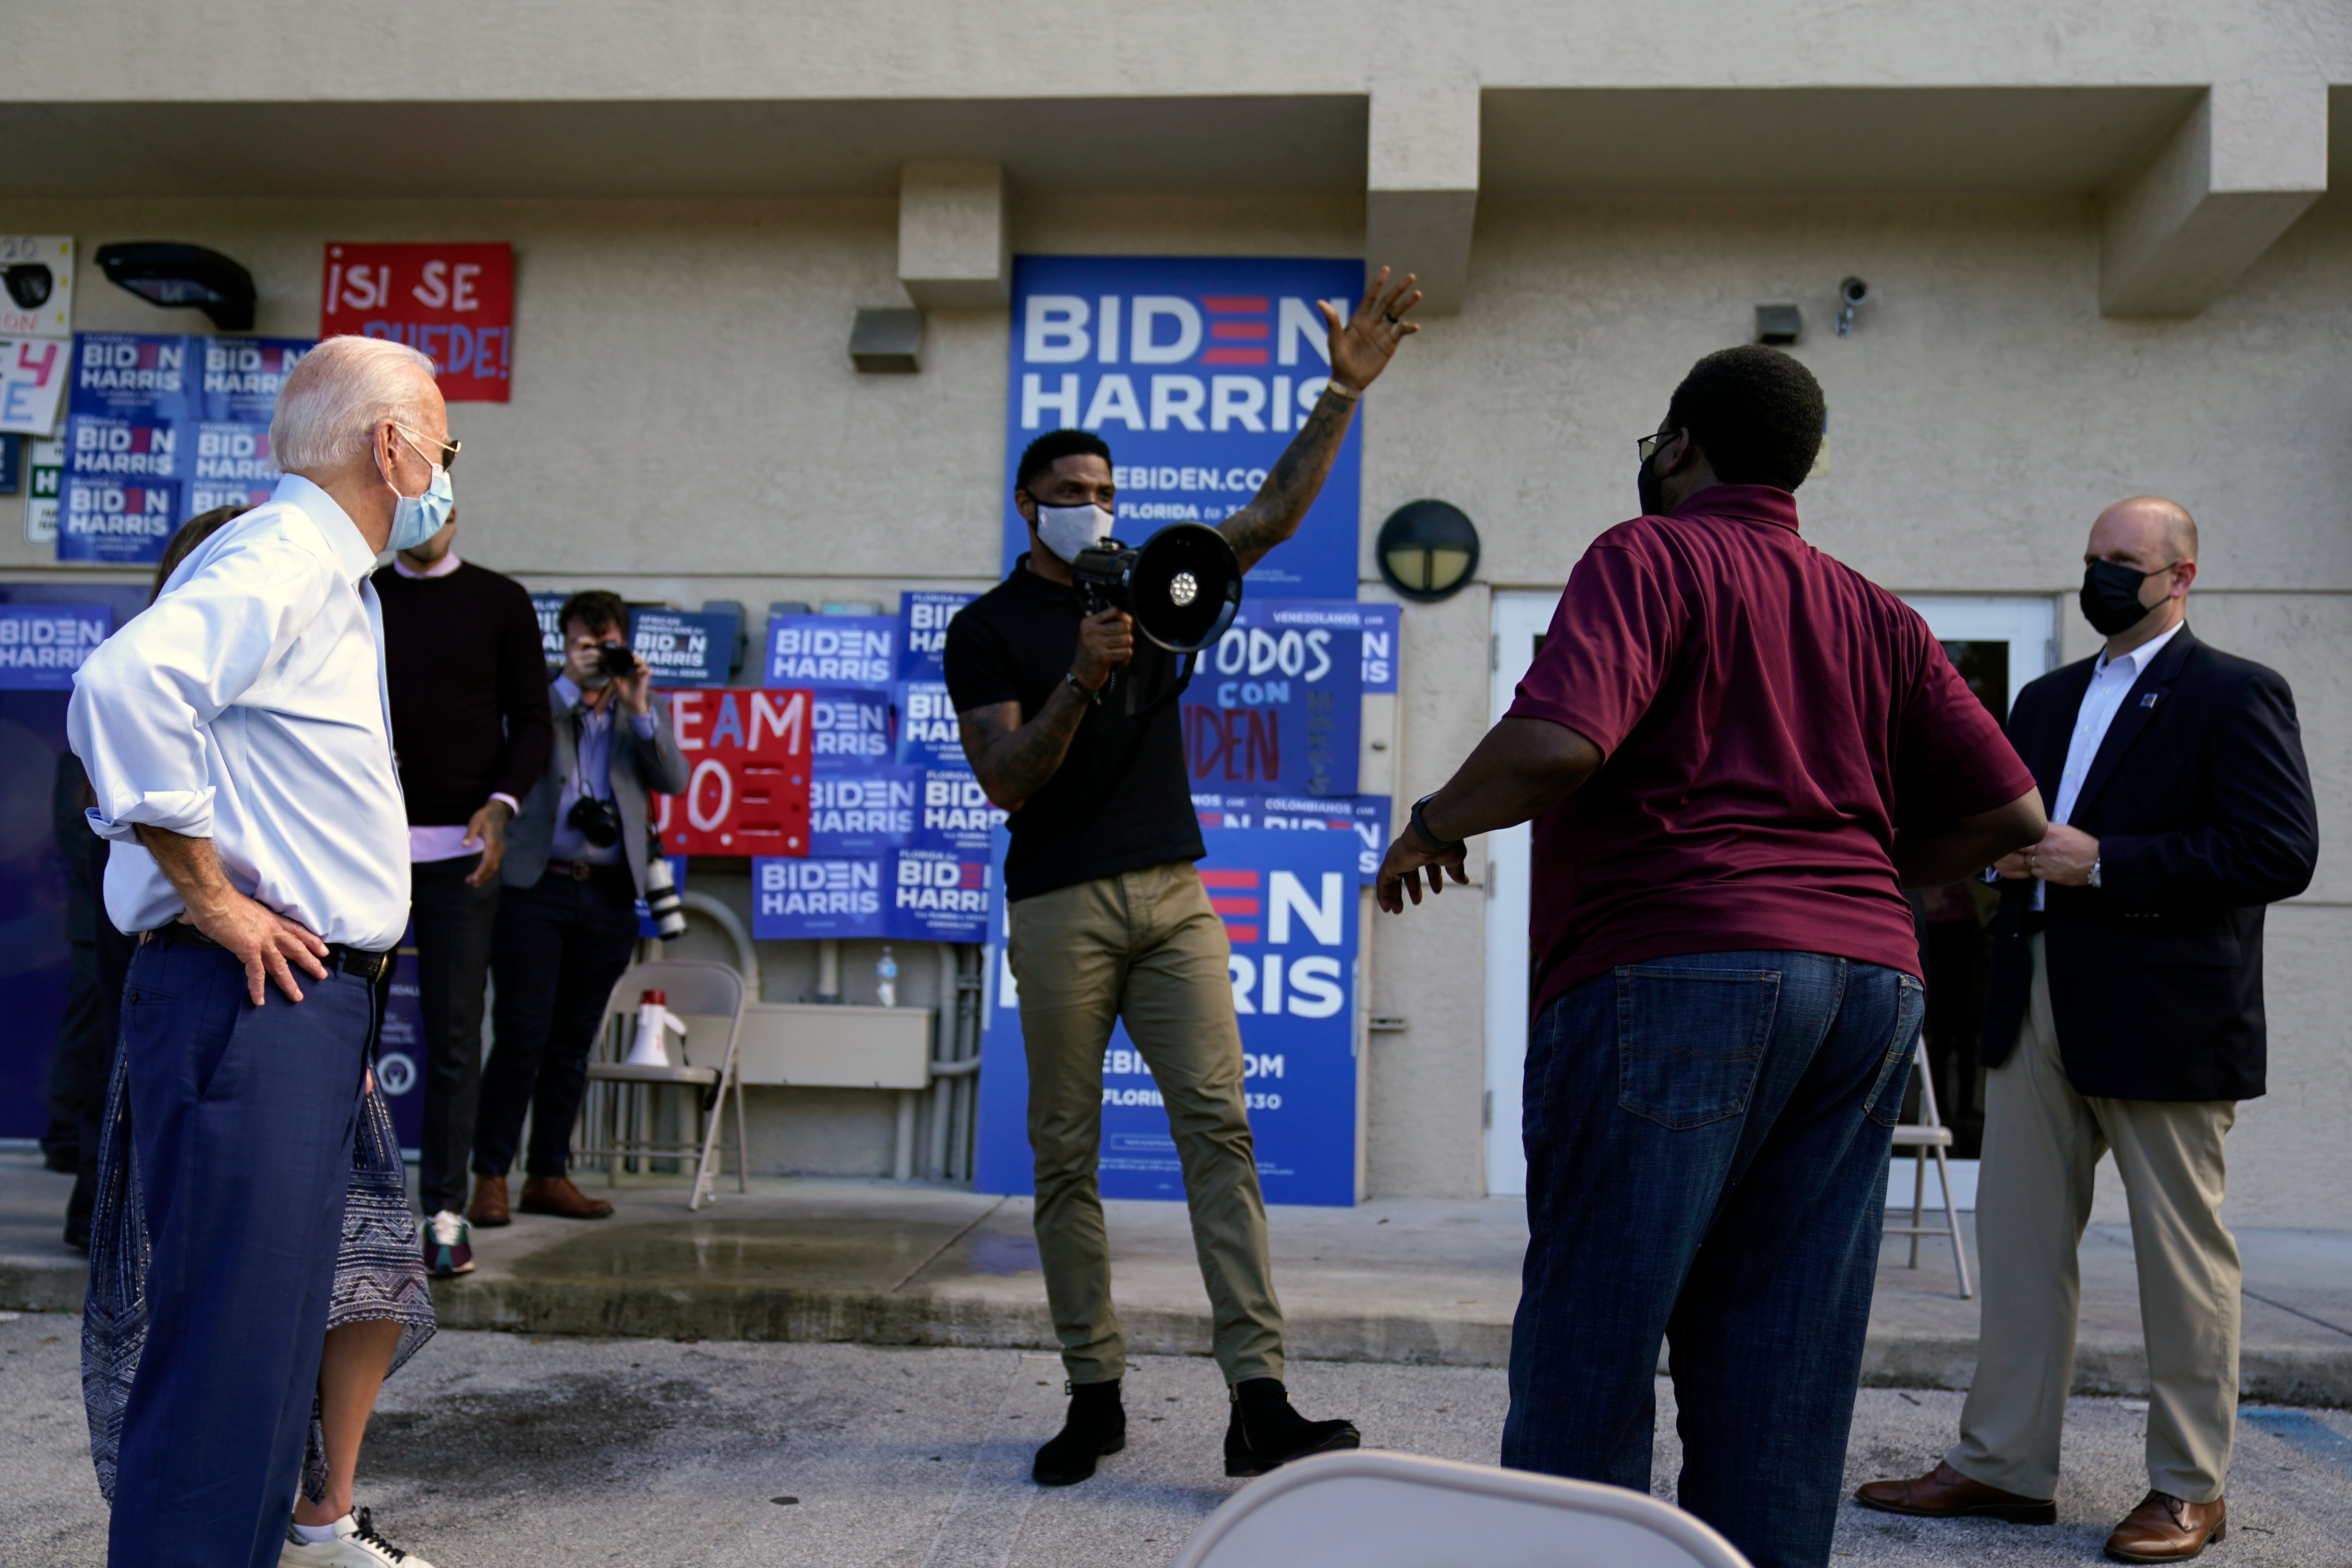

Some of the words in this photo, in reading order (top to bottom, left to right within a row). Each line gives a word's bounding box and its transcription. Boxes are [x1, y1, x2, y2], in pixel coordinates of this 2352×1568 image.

[412, 260, 481, 311] SE
[1024, 295, 1350, 365] BIDEN
[363, 321, 509, 379] EDE!
[81, 369, 181, 391] HARRIS
[204, 371, 288, 393] HARR
[198, 433, 270, 457] BID
[74, 451, 173, 474] HARRIS
[196, 457, 282, 480] HARR
[1112, 465, 1268, 492] EBIDEN.CO
[1117, 502, 1199, 520] FLORIDA
[1204, 504, 1223, 520] to
[68, 513, 168, 536] HARRIS
[1273, 610, 1360, 624] VENEZOLANOS
[0, 619, 104, 644] BIDEN
[634, 633, 707, 653] BIDN
[776, 629, 891, 658] BIDEN
[773, 656, 890, 682] HARRIS
[1217, 680, 1290, 708] CON
[660, 690, 804, 755] EAM
[811, 702, 884, 731] DEN
[810, 730, 887, 755] RRIS
[1183, 704, 1279, 782] IDEN
[925, 780, 995, 807] BID
[924, 806, 1011, 831] HARR
[1264, 798, 1352, 815] COLOMBIANOS
[762, 861, 878, 891] BIDEN
[762, 890, 880, 915] HARRIS
[895, 886, 989, 911] HARRI
[1227, 953, 1344, 1019] RIS
[1103, 1088, 1164, 1107] FLORI
